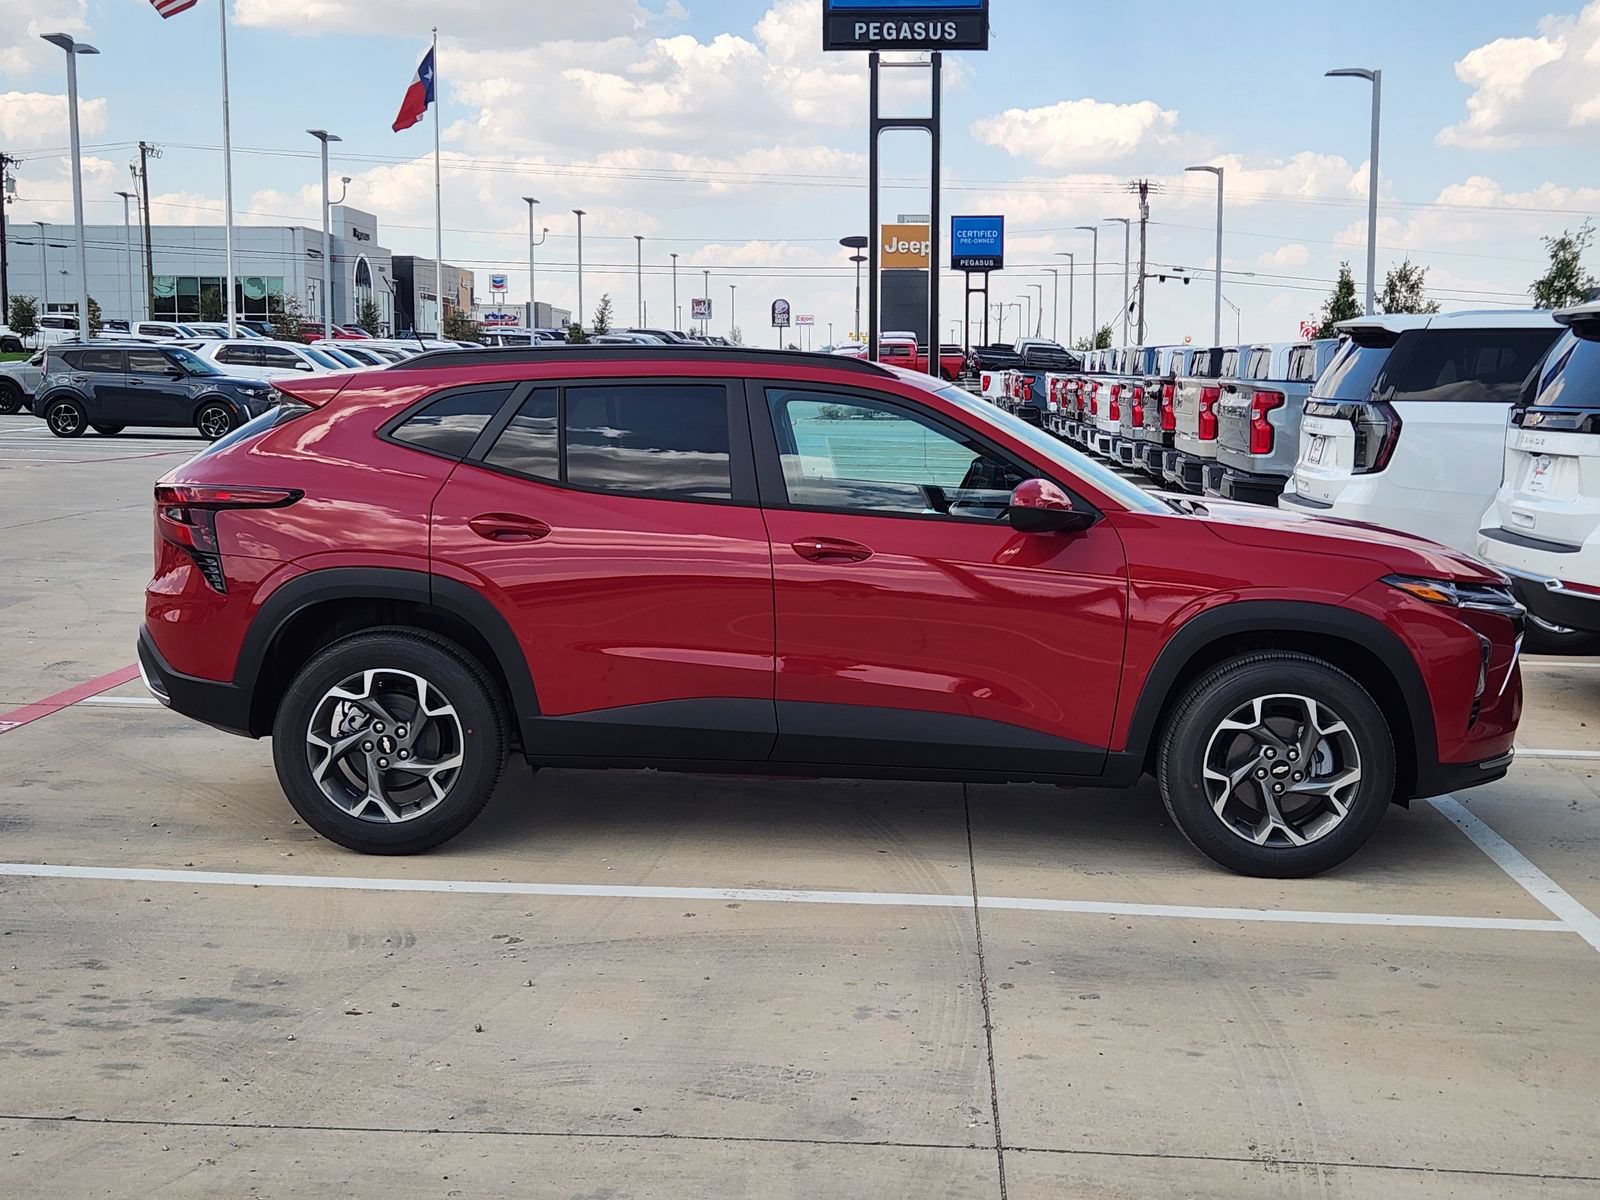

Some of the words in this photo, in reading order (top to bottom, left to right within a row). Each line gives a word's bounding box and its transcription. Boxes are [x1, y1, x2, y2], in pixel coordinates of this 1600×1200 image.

[855, 22, 957, 40] PEGASUS
[957, 230, 998, 238] CERTIFIED
[884, 236, 930, 257] Jeep
